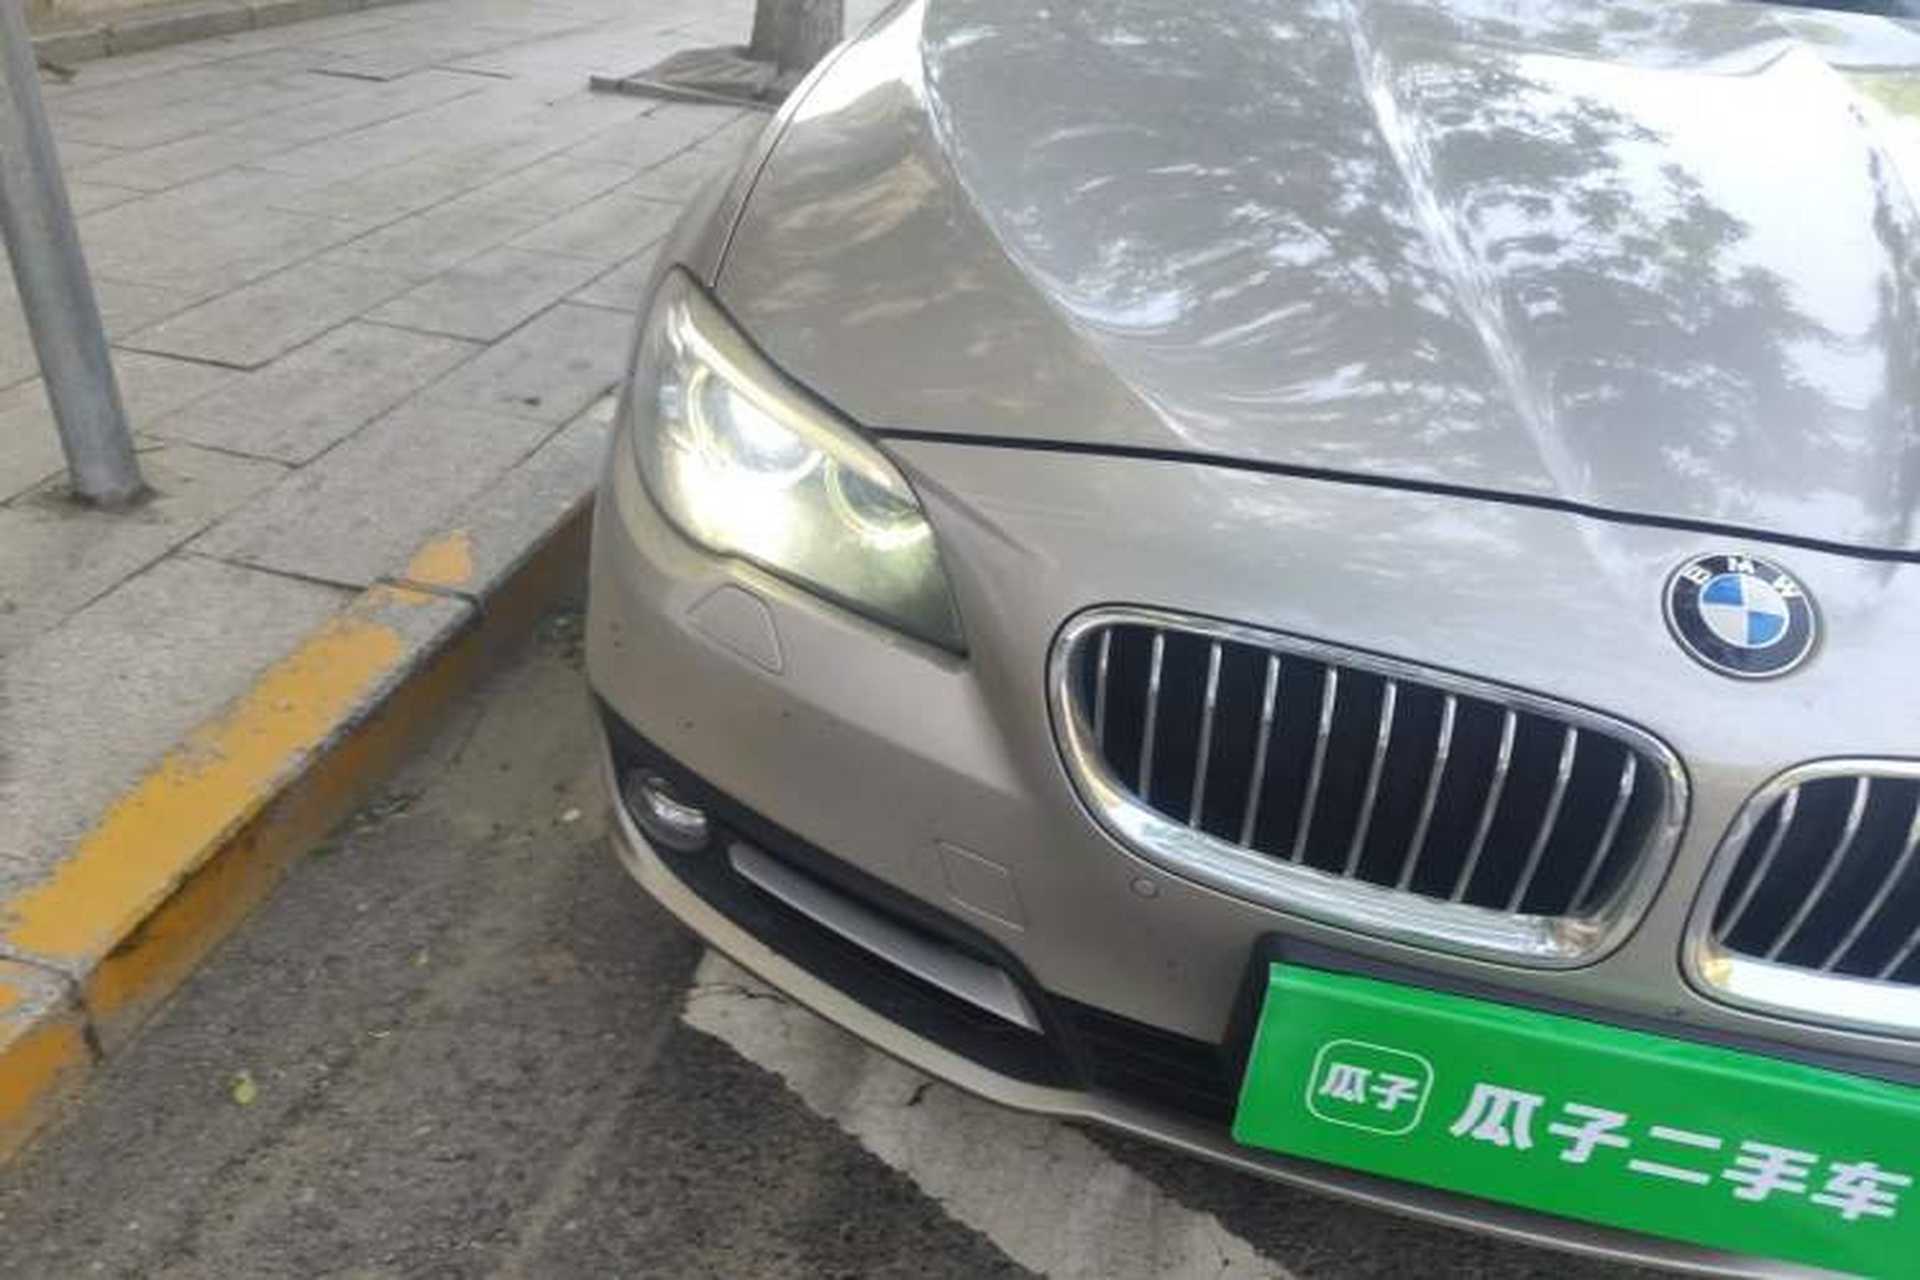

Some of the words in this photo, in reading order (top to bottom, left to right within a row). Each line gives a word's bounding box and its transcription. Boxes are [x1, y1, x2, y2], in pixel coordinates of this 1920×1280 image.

[1680, 555, 1801, 597] BMW
[1320, 1063, 1418, 1112] 瓜子
[1450, 1083, 1912, 1220] 瓜子二手车
